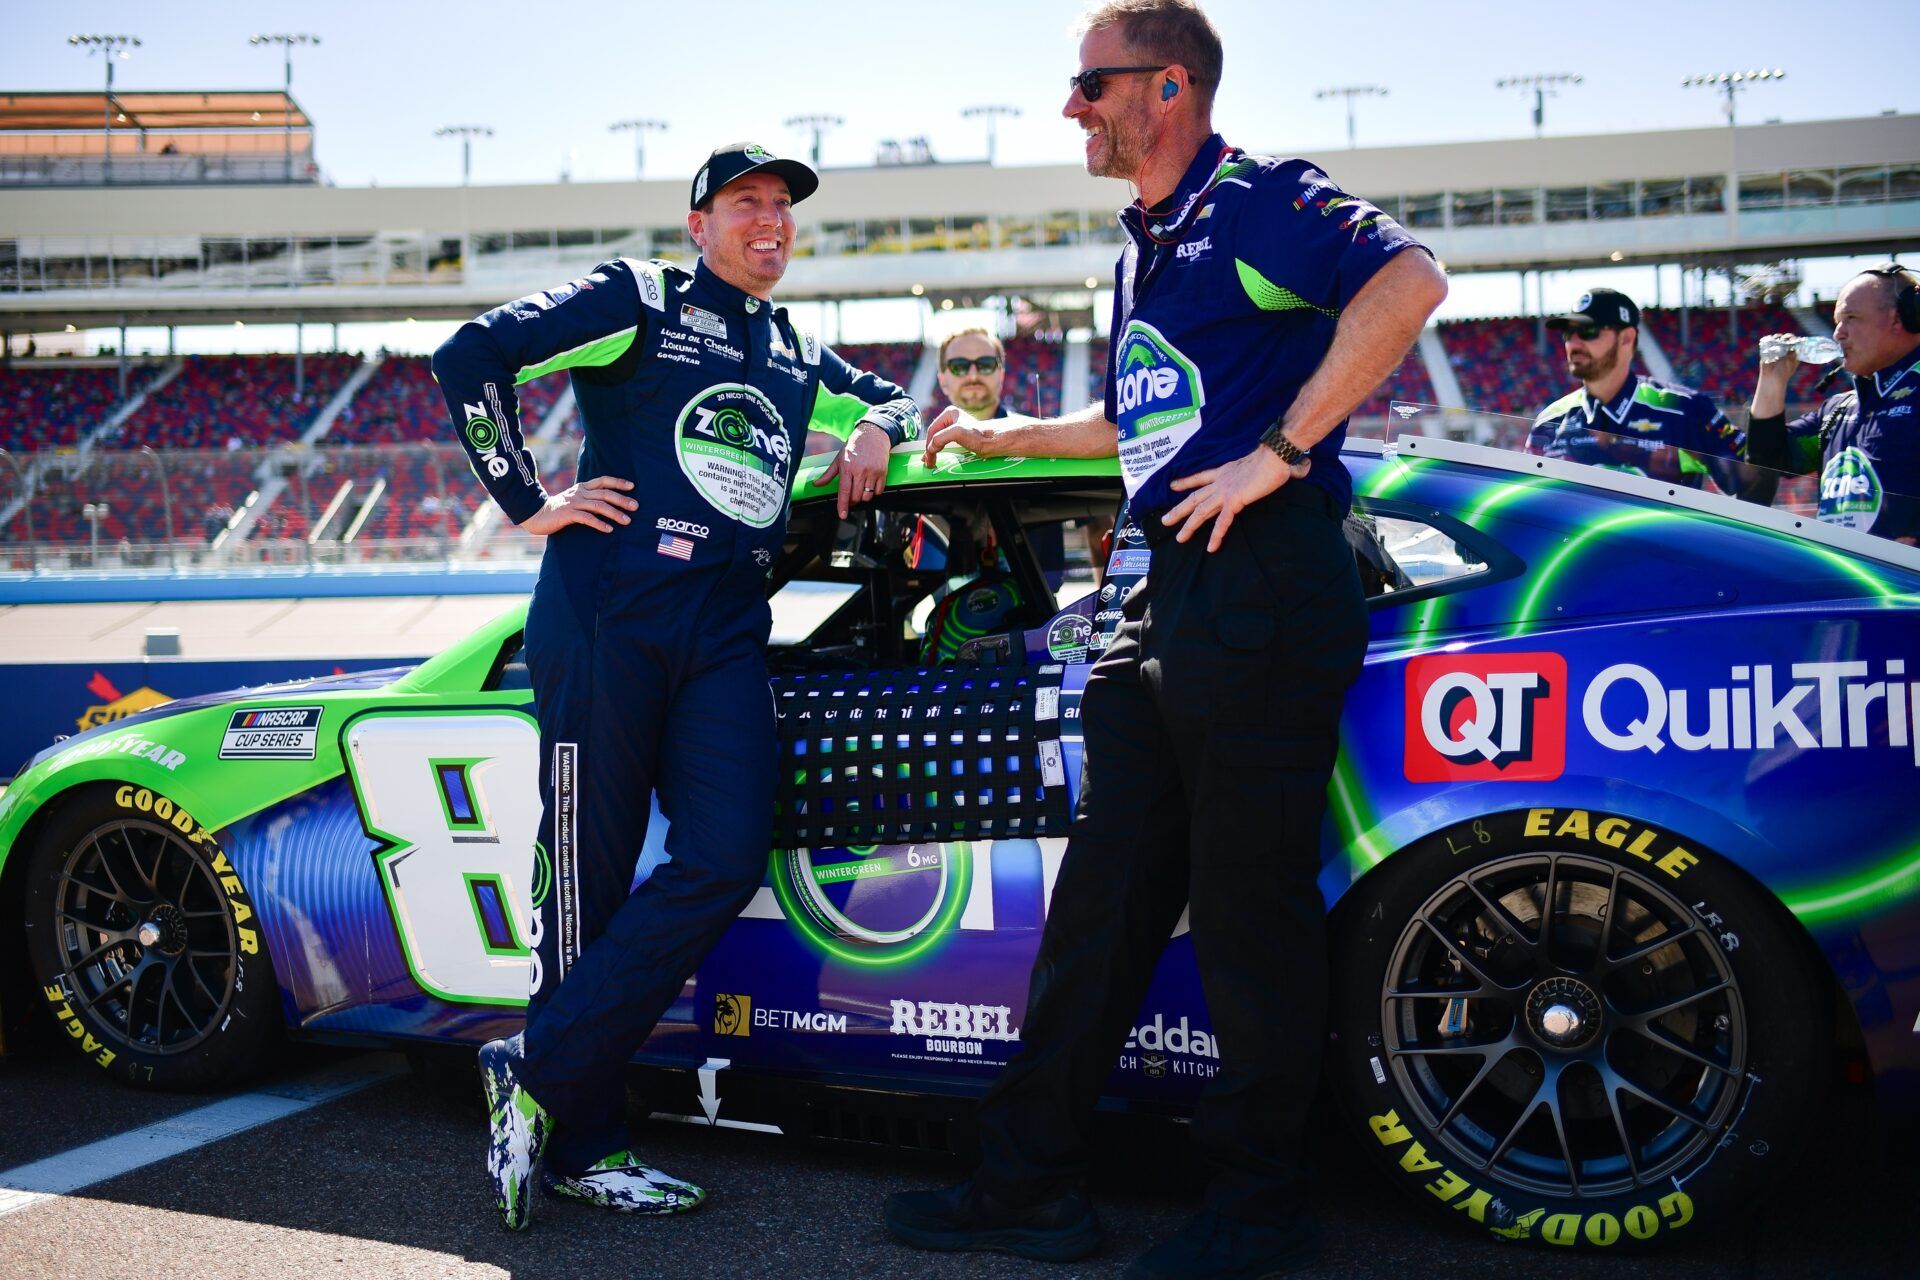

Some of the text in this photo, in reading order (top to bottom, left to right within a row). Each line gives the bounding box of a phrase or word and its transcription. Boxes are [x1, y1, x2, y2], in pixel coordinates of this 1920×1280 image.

[660, 328, 686, 340] LUCAS
[688, 335, 701, 344] OIL
[657, 352, 700, 365] GOODYEAR
[704, 338, 744, 360] Cheddar's
[463, 401, 509, 478] zone
[695, 406, 789, 462] zone
[685, 441, 747, 462] WINTERGREEN
[698, 470, 731, 484] contains
[721, 484, 727, 492] is
[729, 487, 738, 496] an
[656, 517, 709, 539] sparco
[1051, 625, 1092, 642] zone
[258, 711, 308, 726] NASCAR
[1421, 672, 1543, 765] QT
[235, 733, 303, 747] CUP SERIES
[1523, 808, 1699, 879] EAGLE
[342, 708, 543, 1003] 8
[561, 751, 573, 965] WARNING: This product contains nicotine. Nicotine is an
[907, 846, 938, 867] 6 MG
[115, 785, 259, 955] GOODYEAR
[816, 863, 881, 880] WINTERGREEN
[43, 984, 117, 1068] EAGLE
[754, 1008, 847, 1033] BETMGM
[890, 998, 1020, 1042] REBEL
[926, 1038, 983, 1055] BOURBON
[924, 1055, 953, 1063] RESPONSIBLY
[565, 1176, 593, 1198] sparco
[1369, 1108, 1694, 1245] GOODYEAR
